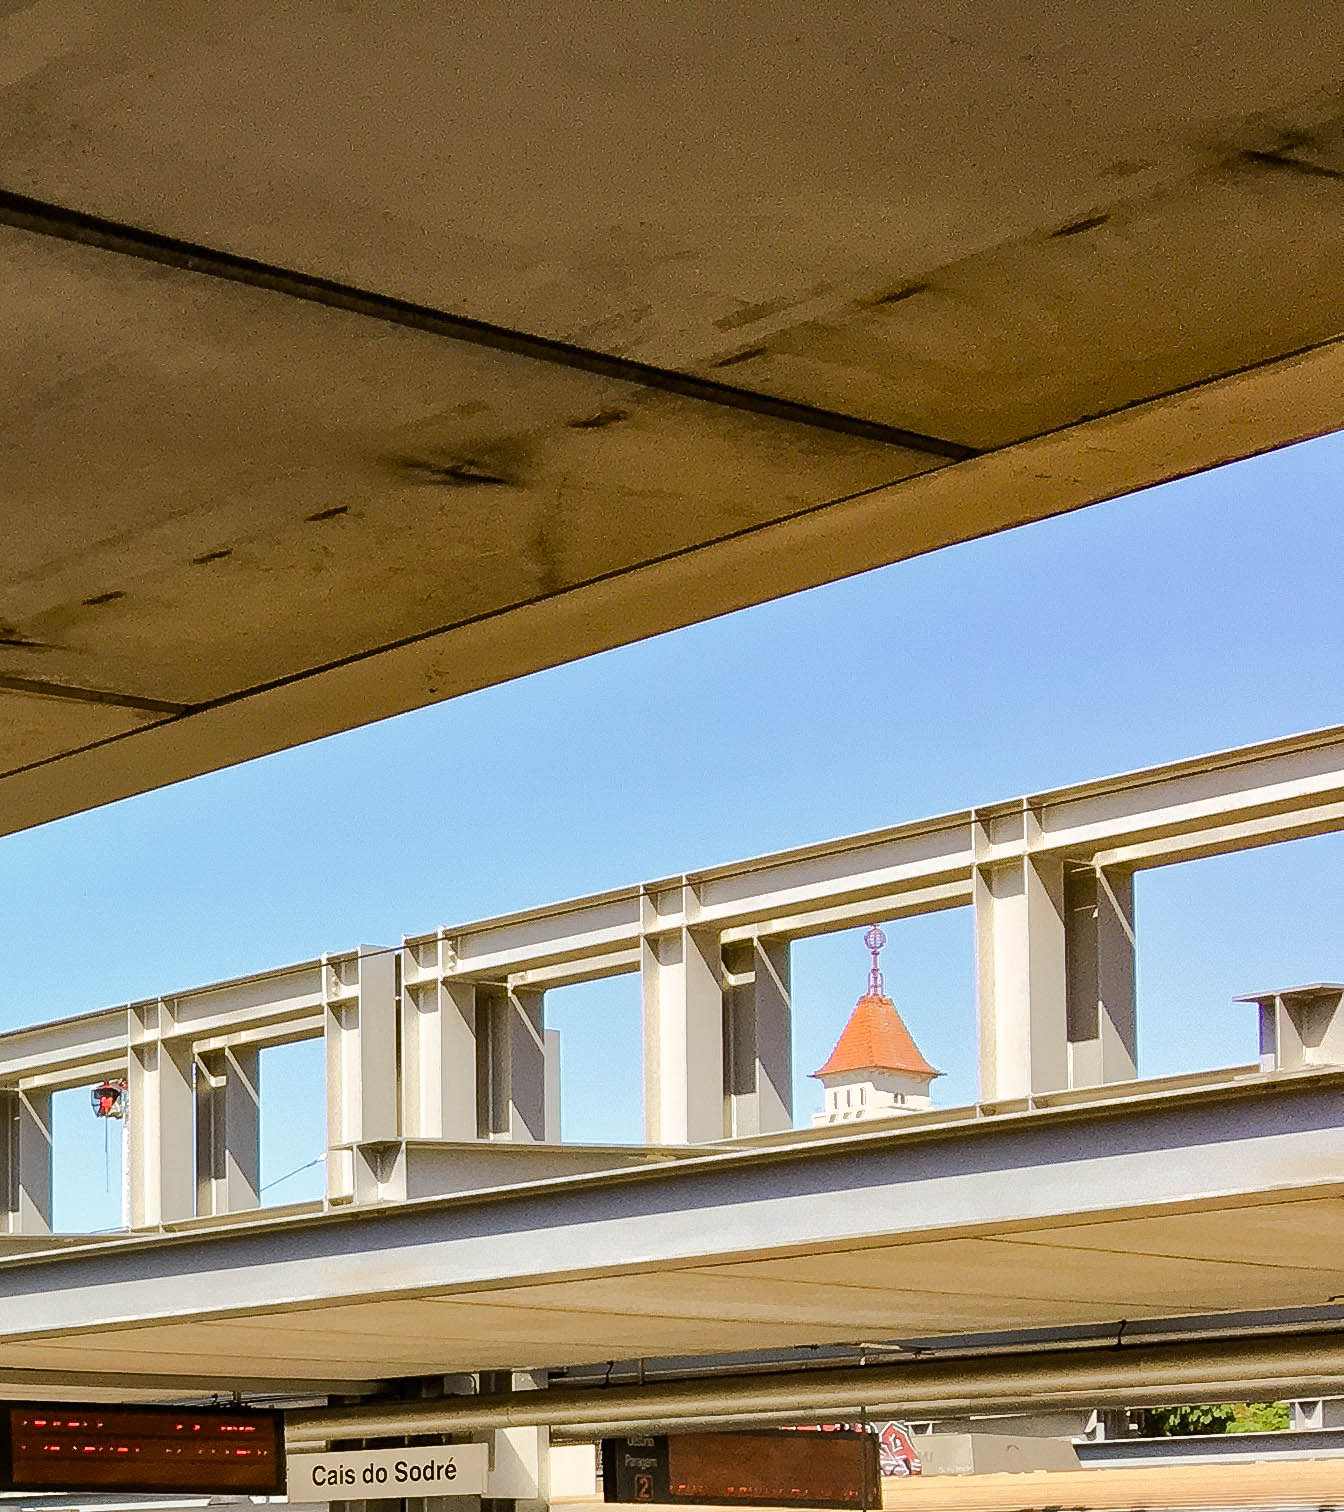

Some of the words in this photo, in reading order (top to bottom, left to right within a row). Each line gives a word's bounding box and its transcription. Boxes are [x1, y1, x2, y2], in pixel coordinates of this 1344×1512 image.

[312, 1464, 356, 1486] Cais
[362, 1462, 388, 1484] do
[394, 1458, 457, 1482] Sodré
[638, 1478, 650, 1499] 2
